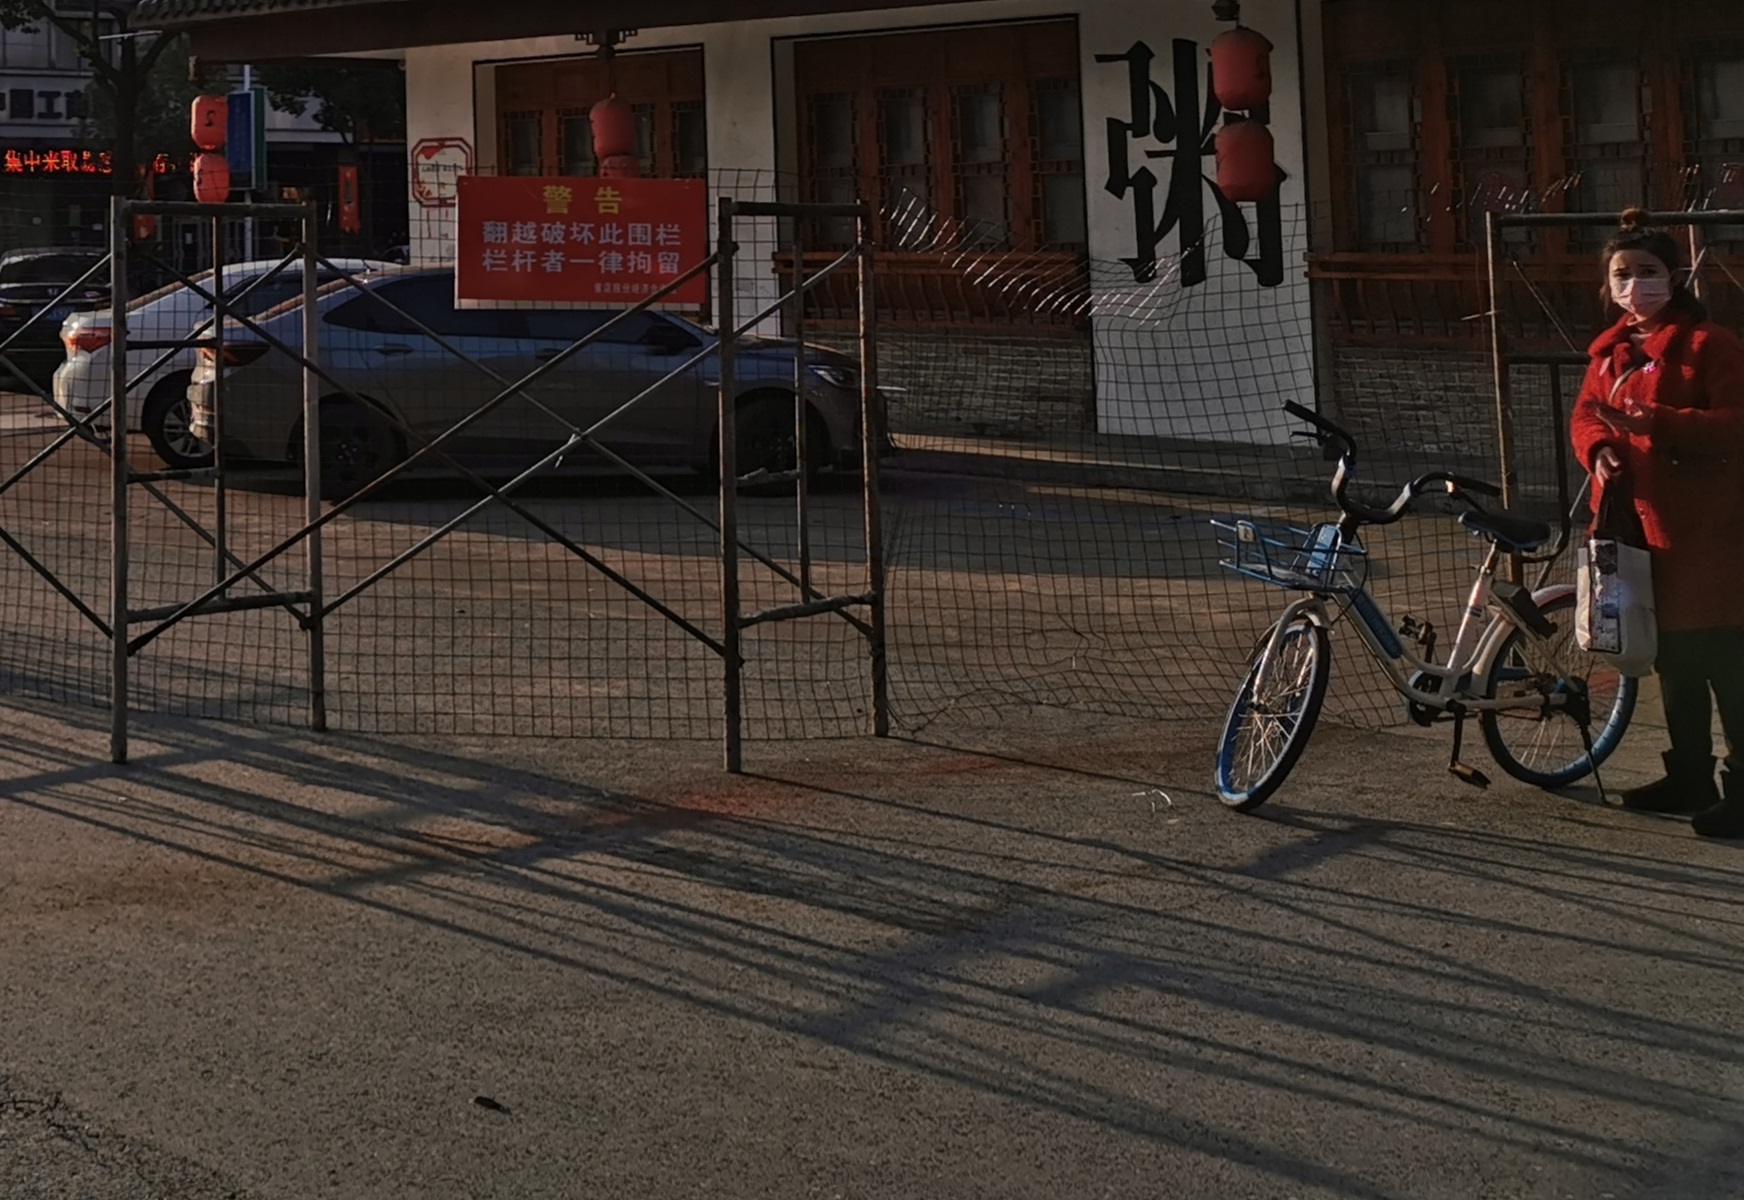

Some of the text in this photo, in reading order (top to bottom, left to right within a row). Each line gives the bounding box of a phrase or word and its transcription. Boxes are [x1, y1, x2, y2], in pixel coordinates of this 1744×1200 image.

[542, 185, 624, 215] 警告
[482, 221, 682, 246] 翻越破坏此围栏
[482, 250, 681, 275] 栏杆者一律拘留
